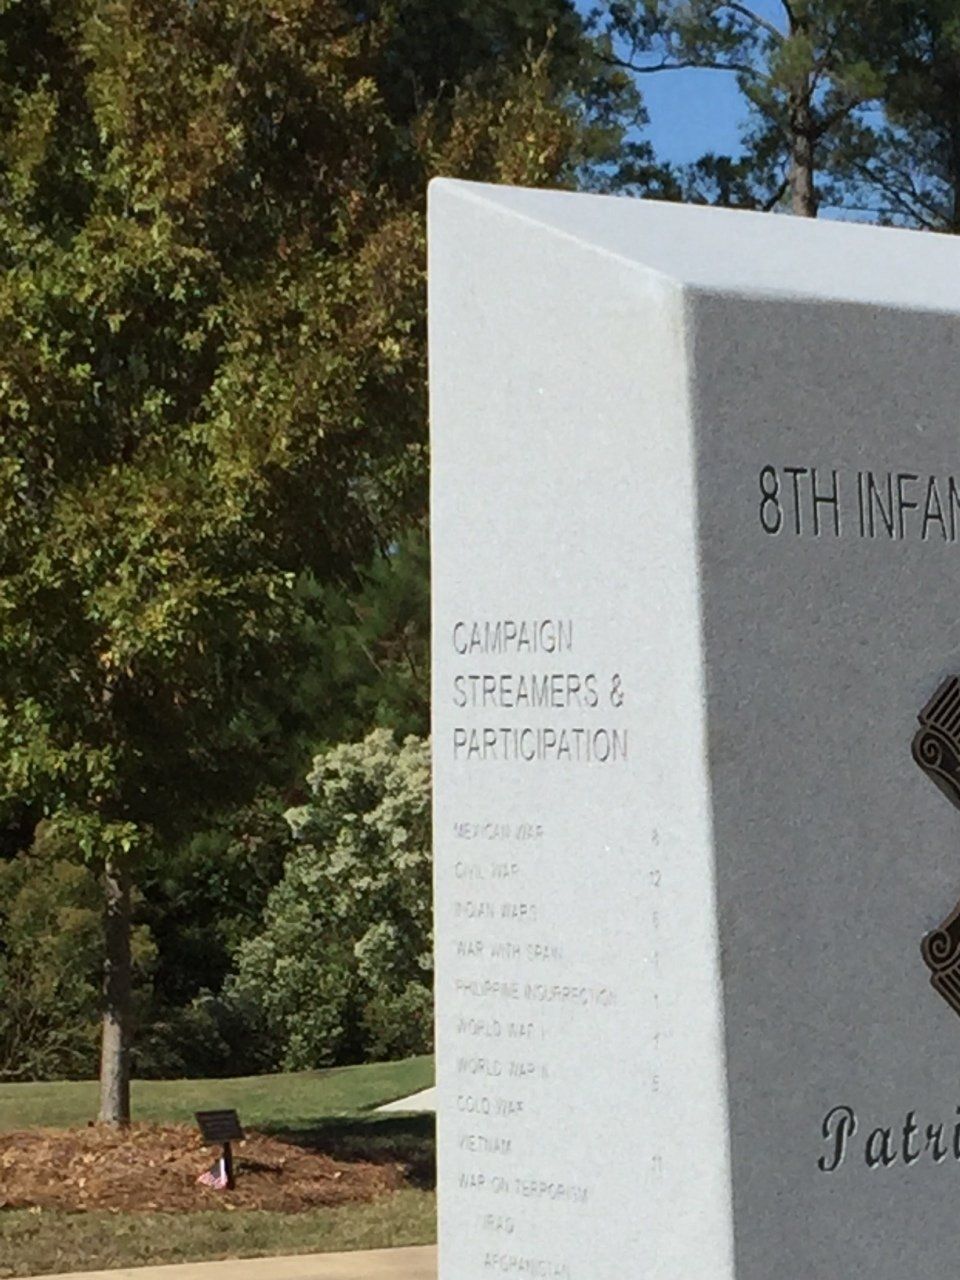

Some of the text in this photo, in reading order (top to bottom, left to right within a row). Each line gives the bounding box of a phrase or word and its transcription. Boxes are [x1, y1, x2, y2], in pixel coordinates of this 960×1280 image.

[759, 464, 840, 537] 8TH
[453, 620, 572, 654] CAMPAIGN
[453, 673, 624, 708] STREAMERS &
[453, 728, 628, 762] PARTICIPATION
